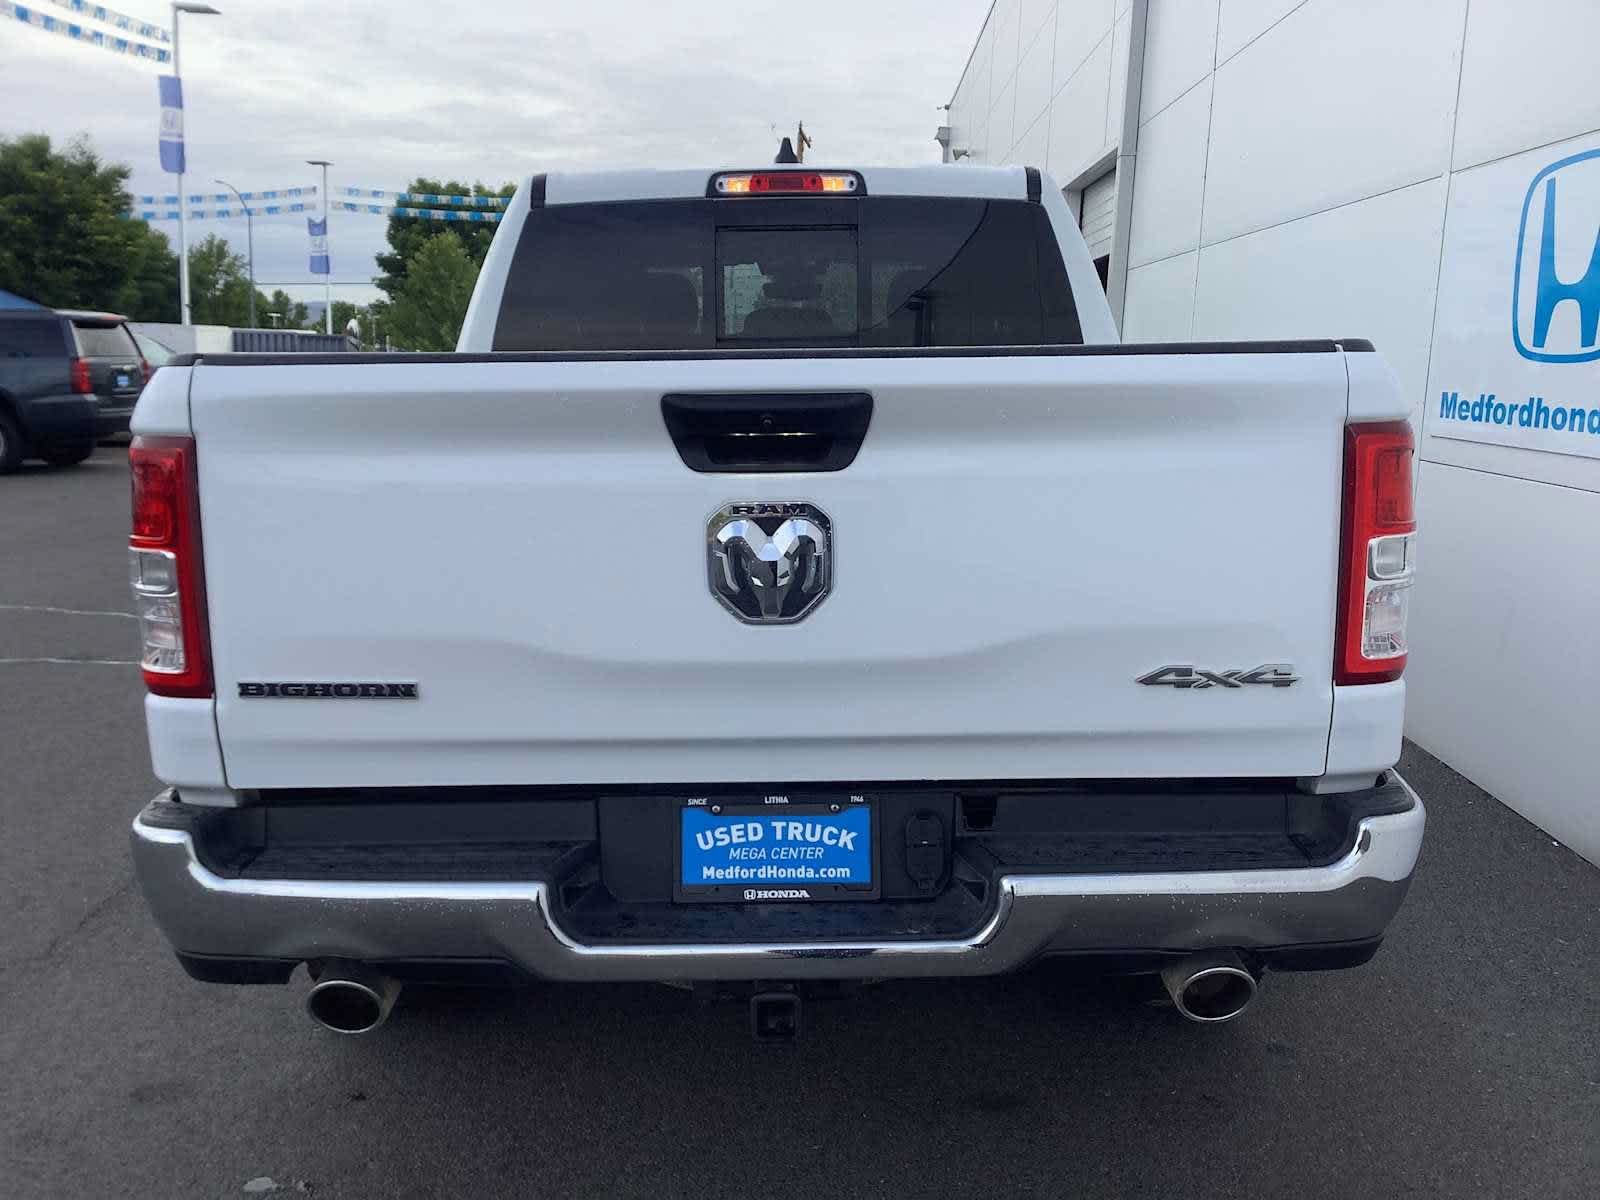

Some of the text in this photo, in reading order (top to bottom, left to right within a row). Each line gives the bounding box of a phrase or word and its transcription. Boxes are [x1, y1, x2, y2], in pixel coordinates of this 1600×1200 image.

[731, 504, 808, 515] RAM
[238, 682, 418, 698] BIGHORN
[687, 798, 707, 806] SINCE
[764, 796, 789, 804] LITHIA
[696, 821, 858, 850] USED TRUCK
[729, 847, 824, 860] MEGA CENTER
[702, 865, 850, 879] MedfordHonda.com
[757, 890, 810, 899] HONDA
